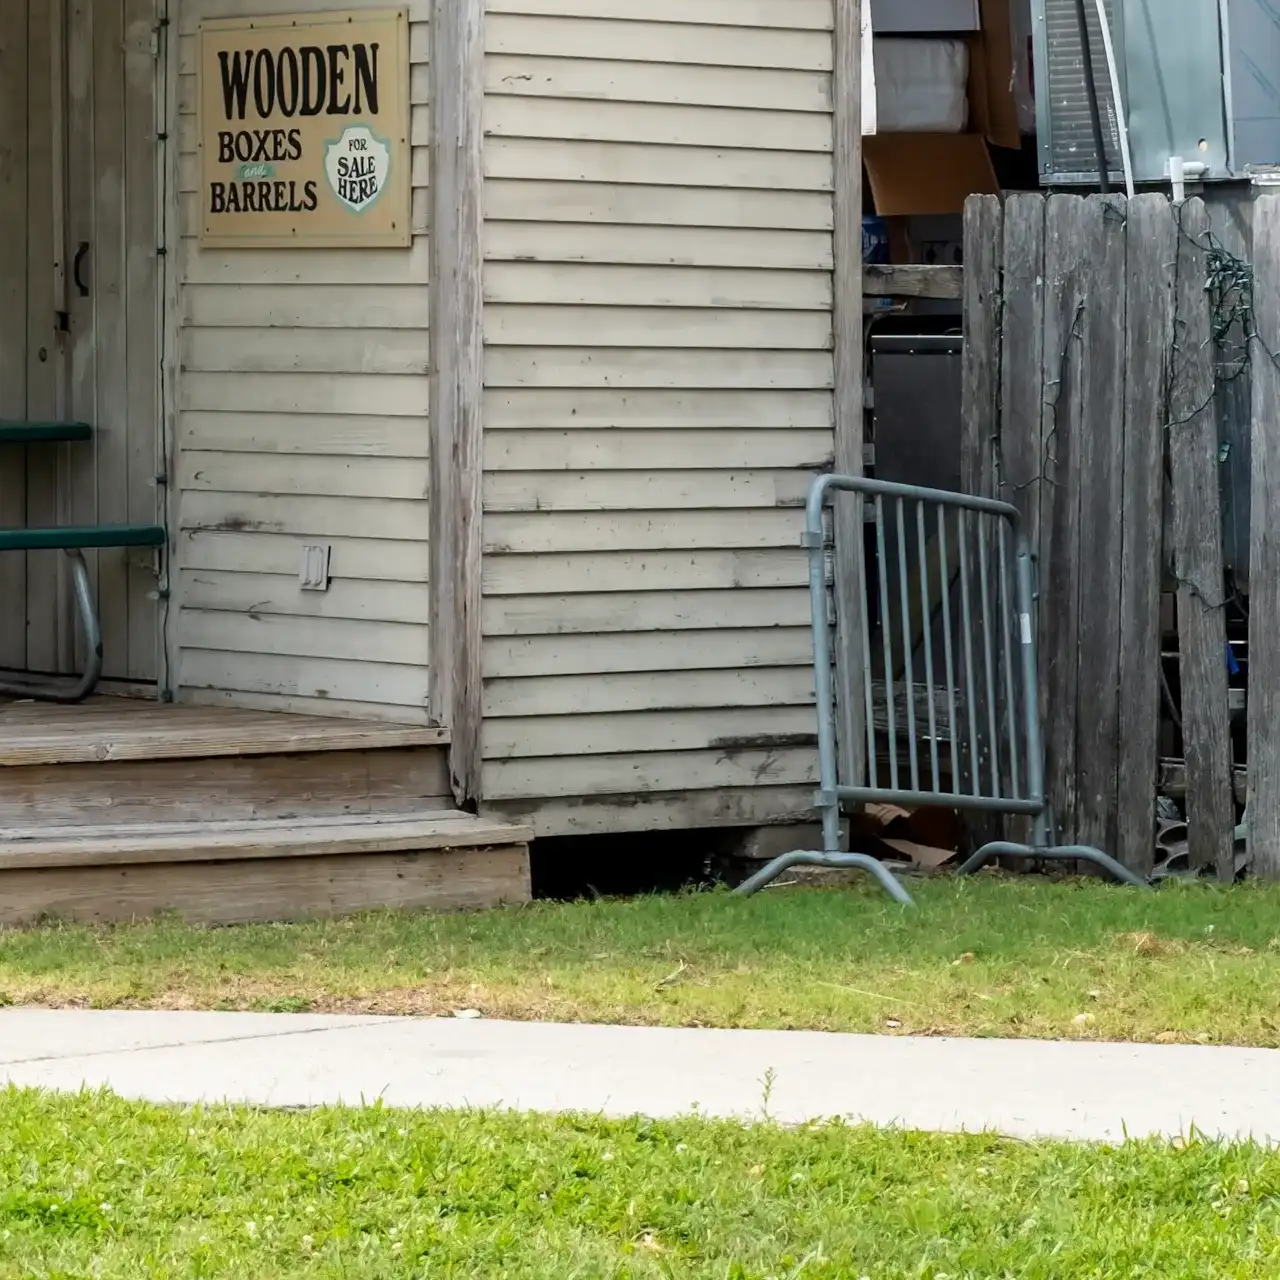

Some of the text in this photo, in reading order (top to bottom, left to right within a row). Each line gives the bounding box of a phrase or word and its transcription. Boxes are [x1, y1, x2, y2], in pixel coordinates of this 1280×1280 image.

[217, 42, 379, 120] WOODEN
[218, 128, 302, 163] BOXES
[349, 138, 368, 152] FOR
[241, 164, 268, 179] and
[337, 155, 376, 178] SALE
[210, 180, 318, 214] BARRELS
[338, 175, 378, 204] HERE
